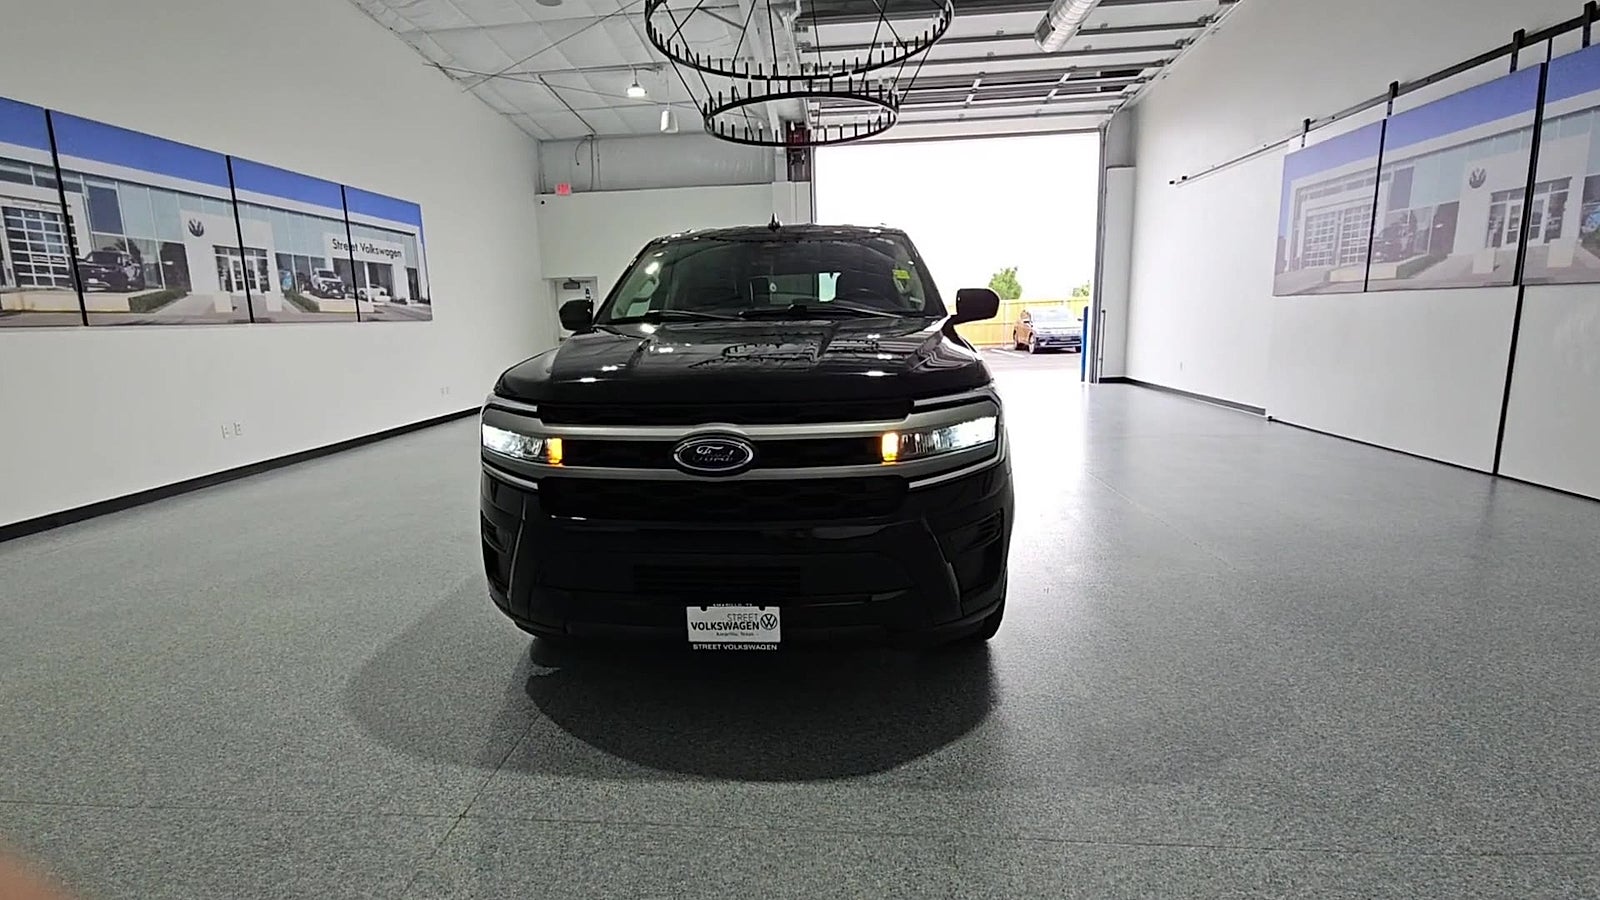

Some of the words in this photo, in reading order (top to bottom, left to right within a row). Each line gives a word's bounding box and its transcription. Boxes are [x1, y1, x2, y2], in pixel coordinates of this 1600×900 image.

[359, 242, 402, 259] Volkswagen
[692, 445, 734, 462] Ford
[727, 613, 758, 622] STREET
[691, 621, 760, 630] VOLKSWAGEN
